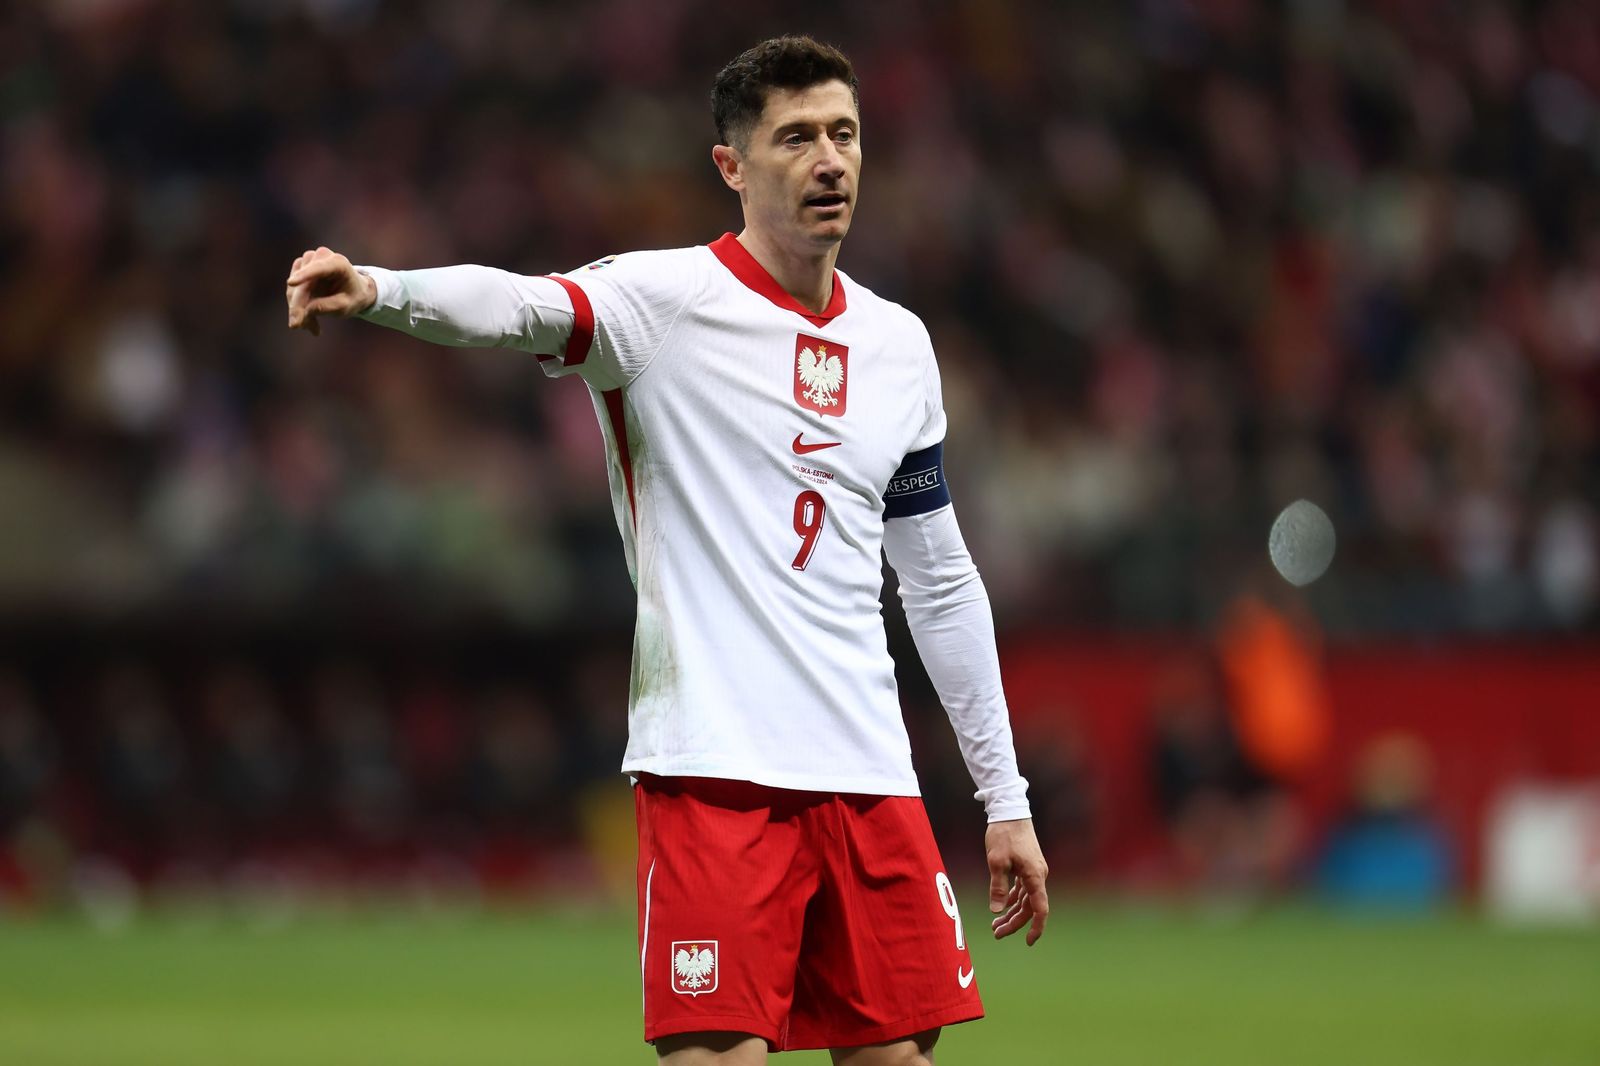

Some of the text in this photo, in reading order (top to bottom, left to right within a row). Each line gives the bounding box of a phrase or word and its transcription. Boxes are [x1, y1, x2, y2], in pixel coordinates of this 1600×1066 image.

[887, 471, 938, 493] RESPECT
[791, 490, 826, 571] 9
[936, 872, 965, 950] 9
